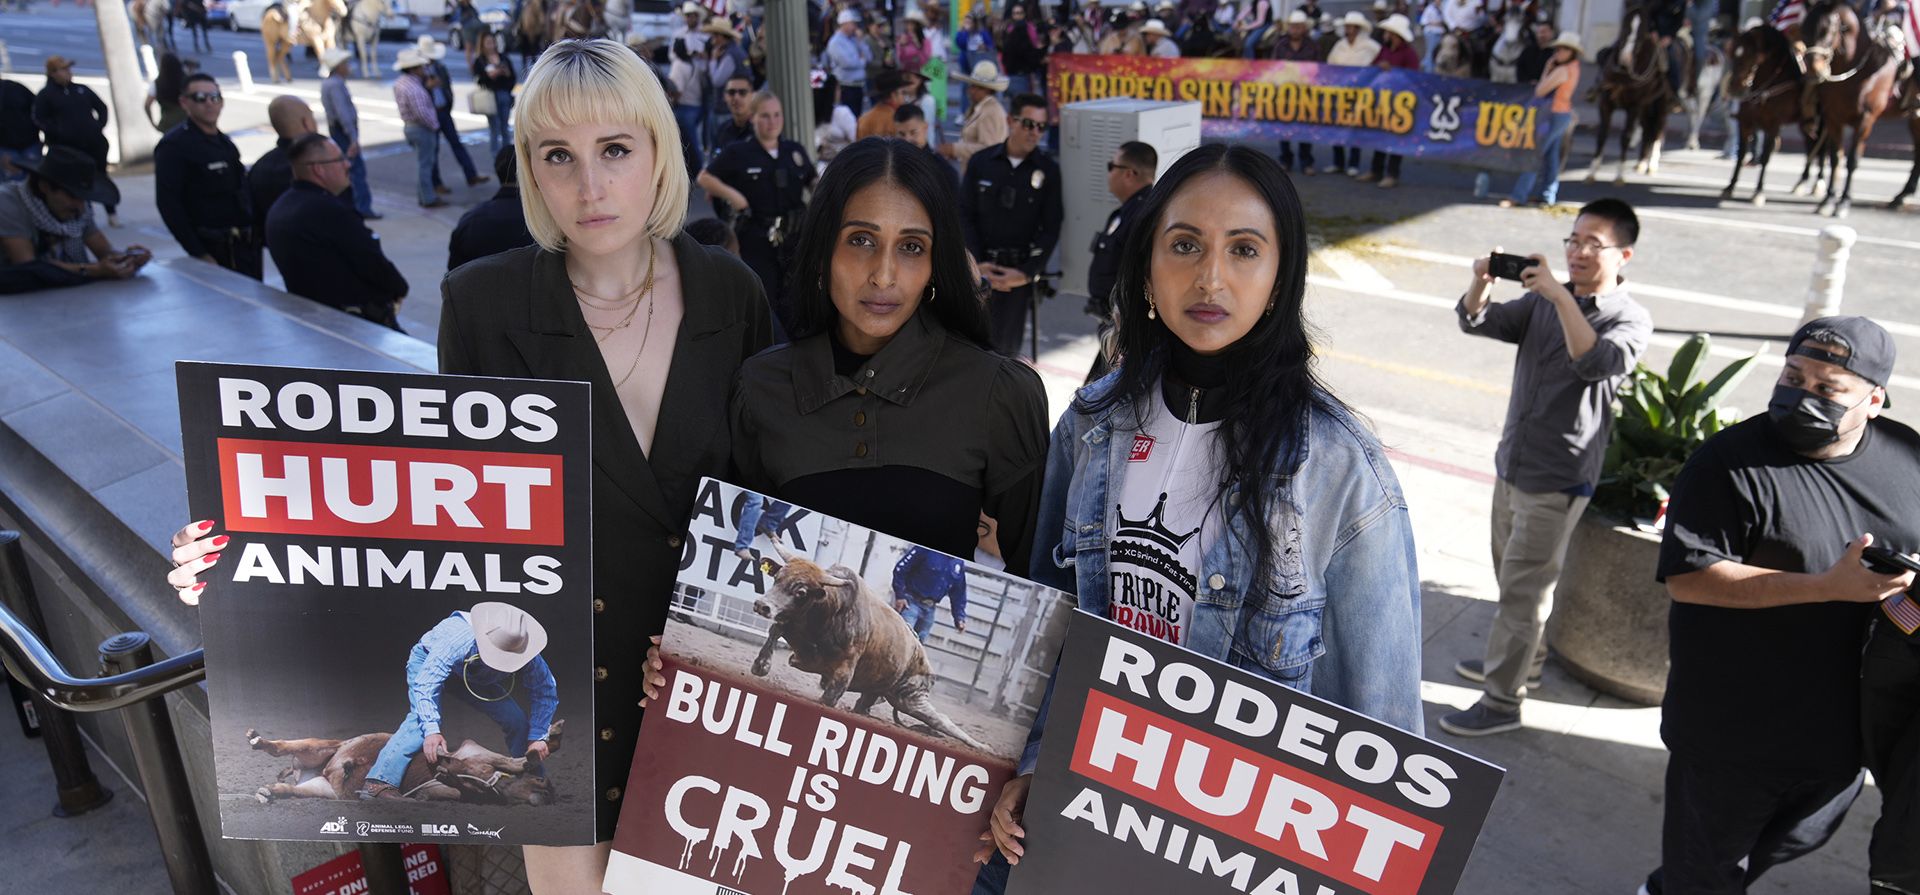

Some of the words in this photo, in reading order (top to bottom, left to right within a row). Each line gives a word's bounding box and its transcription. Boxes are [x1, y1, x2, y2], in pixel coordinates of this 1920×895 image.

[1179, 79, 1233, 118] SIN
[1239, 82, 1416, 134] FRONTERAS
[1476, 101, 1537, 149] USA
[219, 378, 558, 442] RODEOS
[236, 452, 551, 530] HURT
[232, 543, 563, 595] ANIMALS
[1110, 572, 1180, 623] TRIPLE
[1163, 563, 1178, 577] Fat
[1179, 573, 1195, 591] Tire
[666, 670, 792, 757] BULL
[808, 717, 989, 814] RIDING
[1100, 635, 1458, 808] RODEOS
[787, 766, 839, 812] IS
[1089, 707, 1425, 882] HURT
[432, 824, 460, 834] LCA
[664, 775, 914, 895] CRUEL
[1060, 787, 1336, 895] ANIMA
